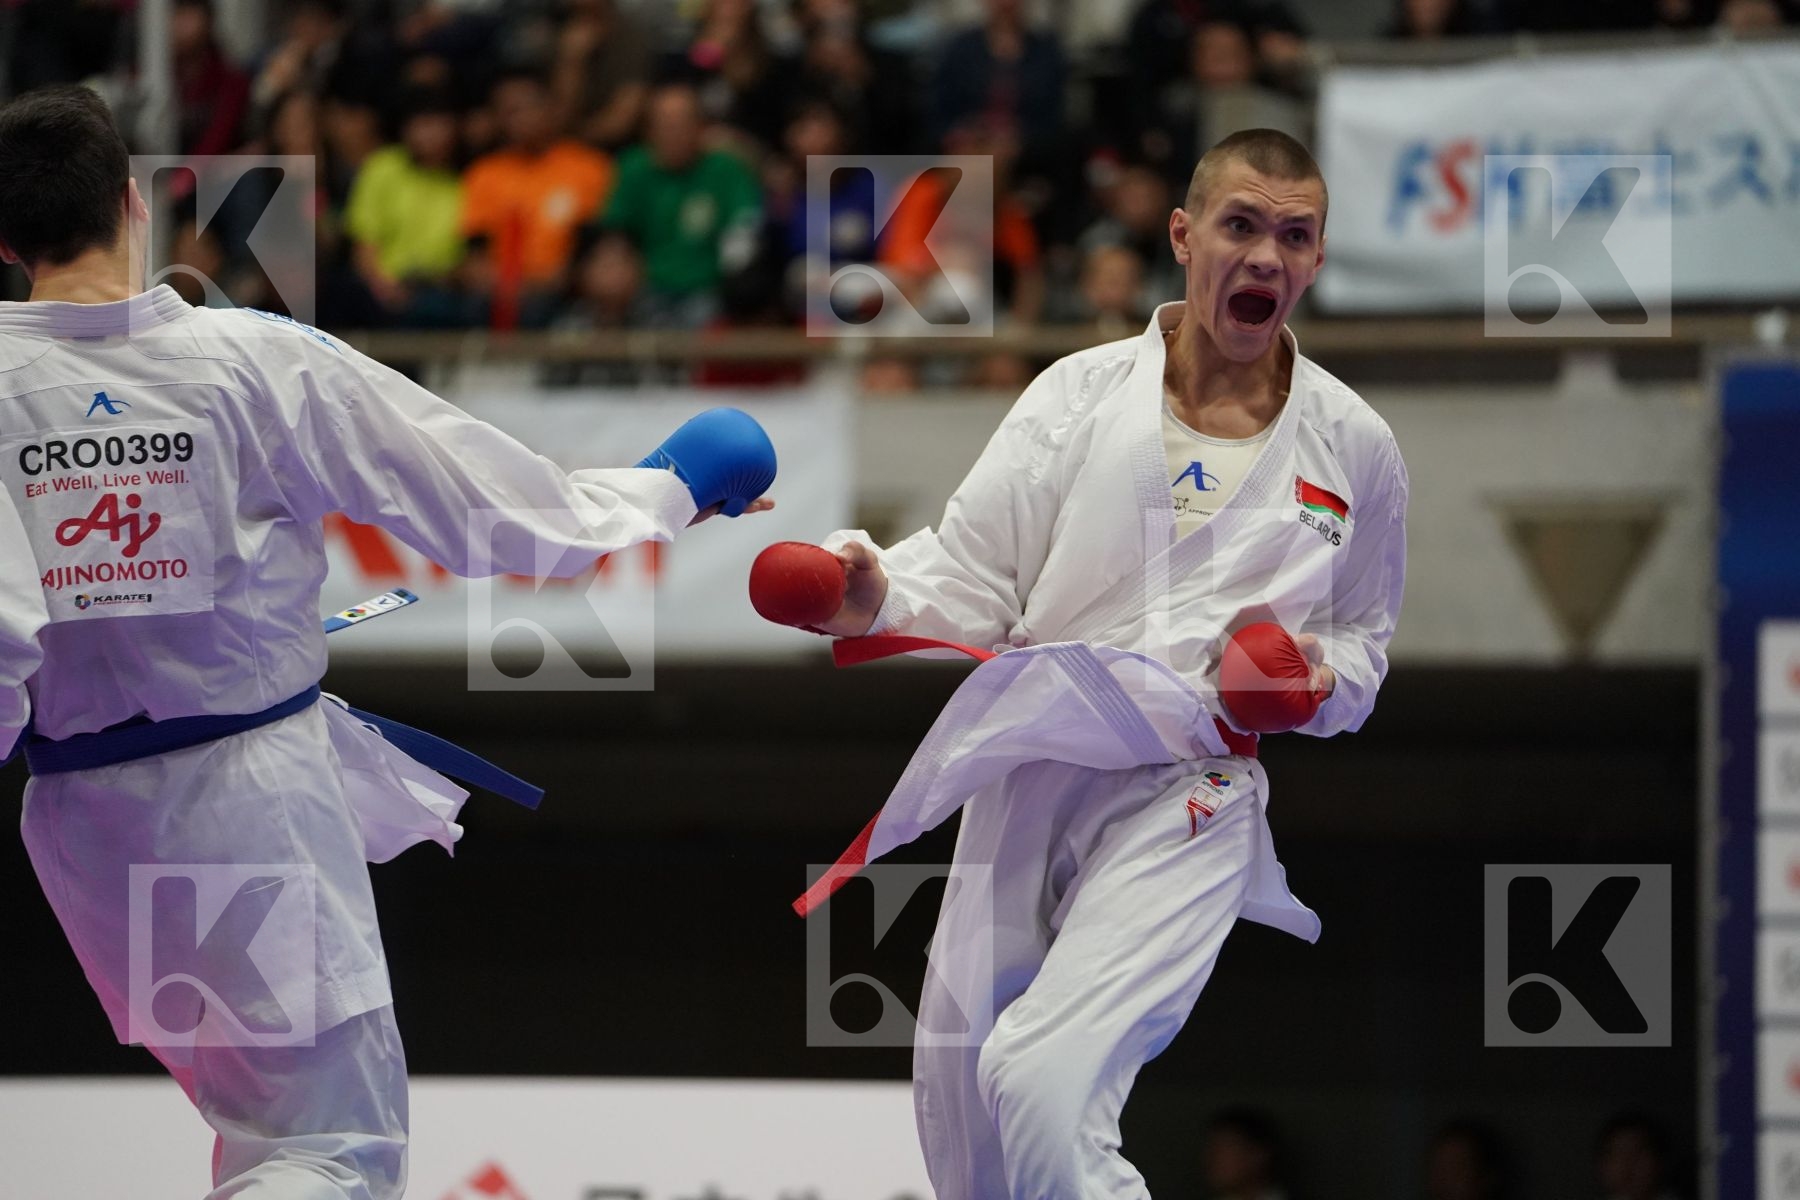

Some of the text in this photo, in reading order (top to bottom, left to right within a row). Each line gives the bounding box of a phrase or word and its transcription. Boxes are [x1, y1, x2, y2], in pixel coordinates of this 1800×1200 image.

[18, 431, 194, 477] CRO0399
[25, 469, 189, 498] Eat Well, Live Well.
[1299, 509, 1342, 547] BELARUS
[40, 558, 188, 591] AJINOMOTO
